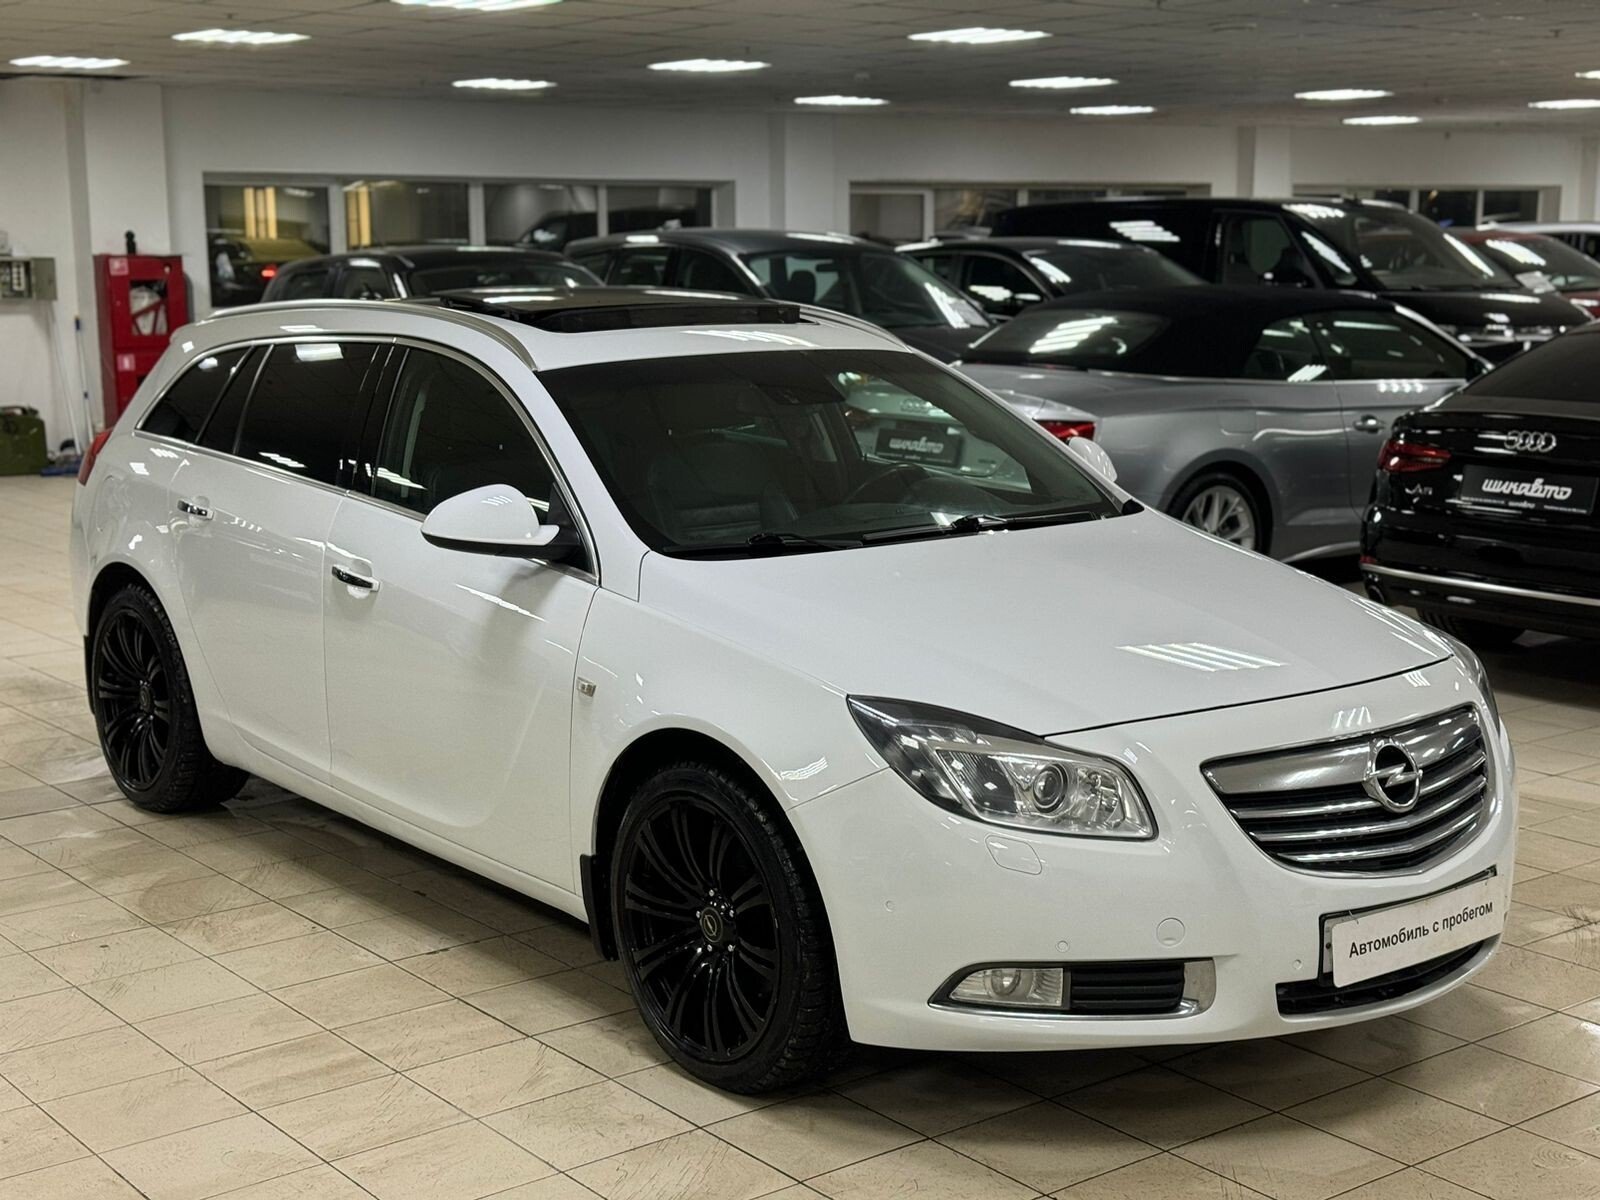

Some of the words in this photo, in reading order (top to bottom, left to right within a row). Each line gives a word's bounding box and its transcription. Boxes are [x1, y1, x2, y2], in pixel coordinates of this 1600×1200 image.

[1349, 927, 1430, 958] Автомобиль
[1432, 920, 1440, 933] с
[1442, 902, 1494, 931] пробегом
